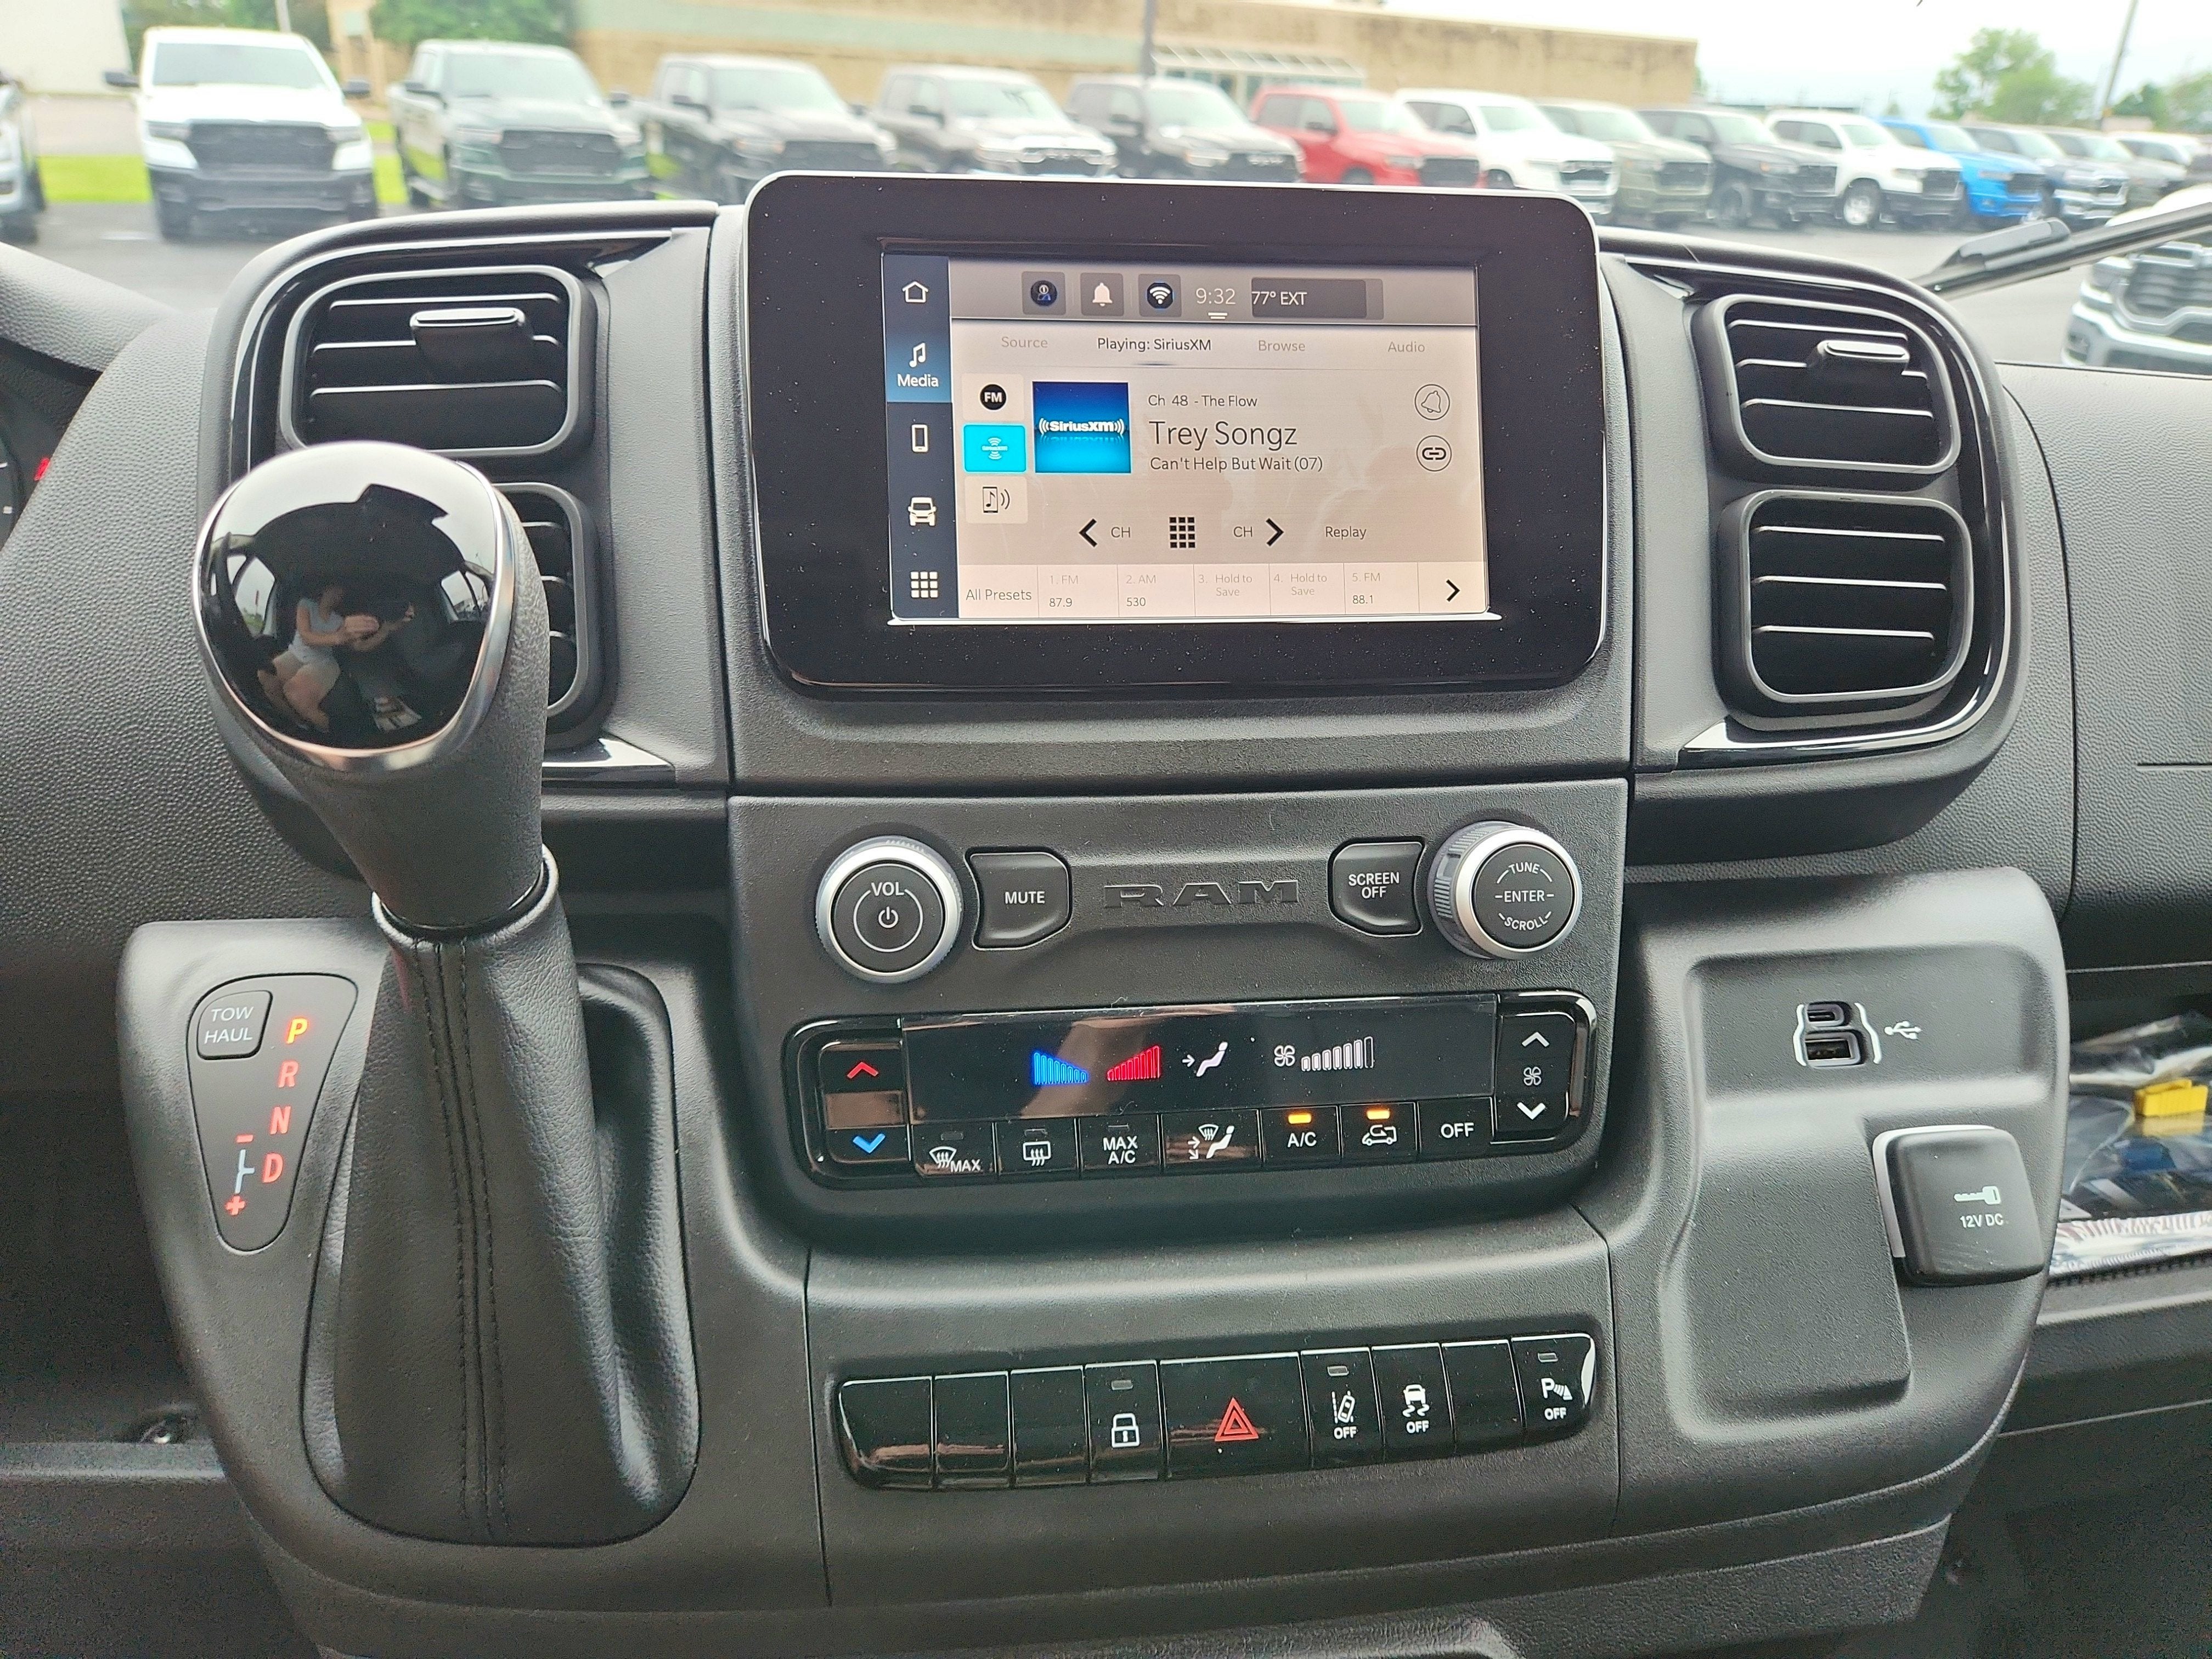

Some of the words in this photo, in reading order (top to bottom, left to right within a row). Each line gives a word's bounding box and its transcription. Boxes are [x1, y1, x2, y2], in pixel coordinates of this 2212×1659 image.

[1195, 288, 1236, 304] 9:32
[1280, 292, 1307, 306] EXT
[1002, 336, 1048, 348] Source
[1098, 338, 1150, 352] Playing:
[1154, 338, 1211, 351] SiriusXM
[1259, 341, 1306, 352] Browse
[1388, 341, 1425, 353] Audio
[898, 374, 938, 387] Media
[984, 392, 1002, 403] FM
[1148, 395, 1165, 407] Ch
[1172, 395, 1188, 407] 48
[1202, 396, 1225, 407] The
[1229, 396, 1257, 407] Flow
[1149, 421, 1208, 451] Trey
[1215, 421, 1297, 450] Songz
[1150, 457, 1189, 470] Can't
[1194, 458, 1227, 473] Help
[1232, 458, 1256, 470] But
[1259, 457, 1291, 470] Wait
[1294, 457, 1323, 472] (07)
[1111, 527, 1131, 538] CH
[1233, 527, 1253, 538] CH
[1325, 527, 1367, 540] Replay
[1062, 575, 1079, 584] FM
[1138, 575, 1156, 584] AM
[1216, 574, 1239, 583] Hold
[1242, 575, 1252, 583] to
[1291, 573, 1314, 583] Hold
[1317, 574, 1327, 583] to
[1364, 573, 1381, 582] FM
[966, 589, 981, 601] All
[985, 589, 1032, 601] Presets
[1216, 587, 1240, 597] Save
[1291, 586, 1315, 596] Save
[1049, 597, 1073, 608] 87.9
[1126, 597, 1146, 607] 530
[1352, 595, 1374, 605] 88.1
[1508, 861, 1541, 874] TUNE
[1348, 871, 1400, 887] SCREEN
[871, 882, 904, 896] VOL
[1104, 880, 1300, 908] RAM
[1361, 886, 1386, 899] OFF
[1005, 891, 1045, 904] MUTE
[1504, 890, 1545, 902] ENTER
[1504, 916, 1548, 931] SCROLL
[211, 1006, 253, 1022] TOW
[204, 1027, 253, 1043] HAUL
[287, 1018, 309, 1043] P
[278, 1061, 298, 1088] R
[269, 1105, 291, 1135] N
[1441, 1122, 1475, 1139] OFF
[1103, 1136, 1138, 1151] MAX
[1287, 1132, 1317, 1148] A/C
[1108, 1149, 1136, 1165] A/C
[262, 1153, 283, 1183] D
[950, 1158, 981, 1173] MAX
[1960, 1215, 1982, 1228] 12V
[1985, 1213, 2003, 1226] DC
[1544, 1407, 1567, 1420] OFF
[1334, 1426, 1357, 1440] OFF
[1406, 1420, 1429, 1434] OFF
